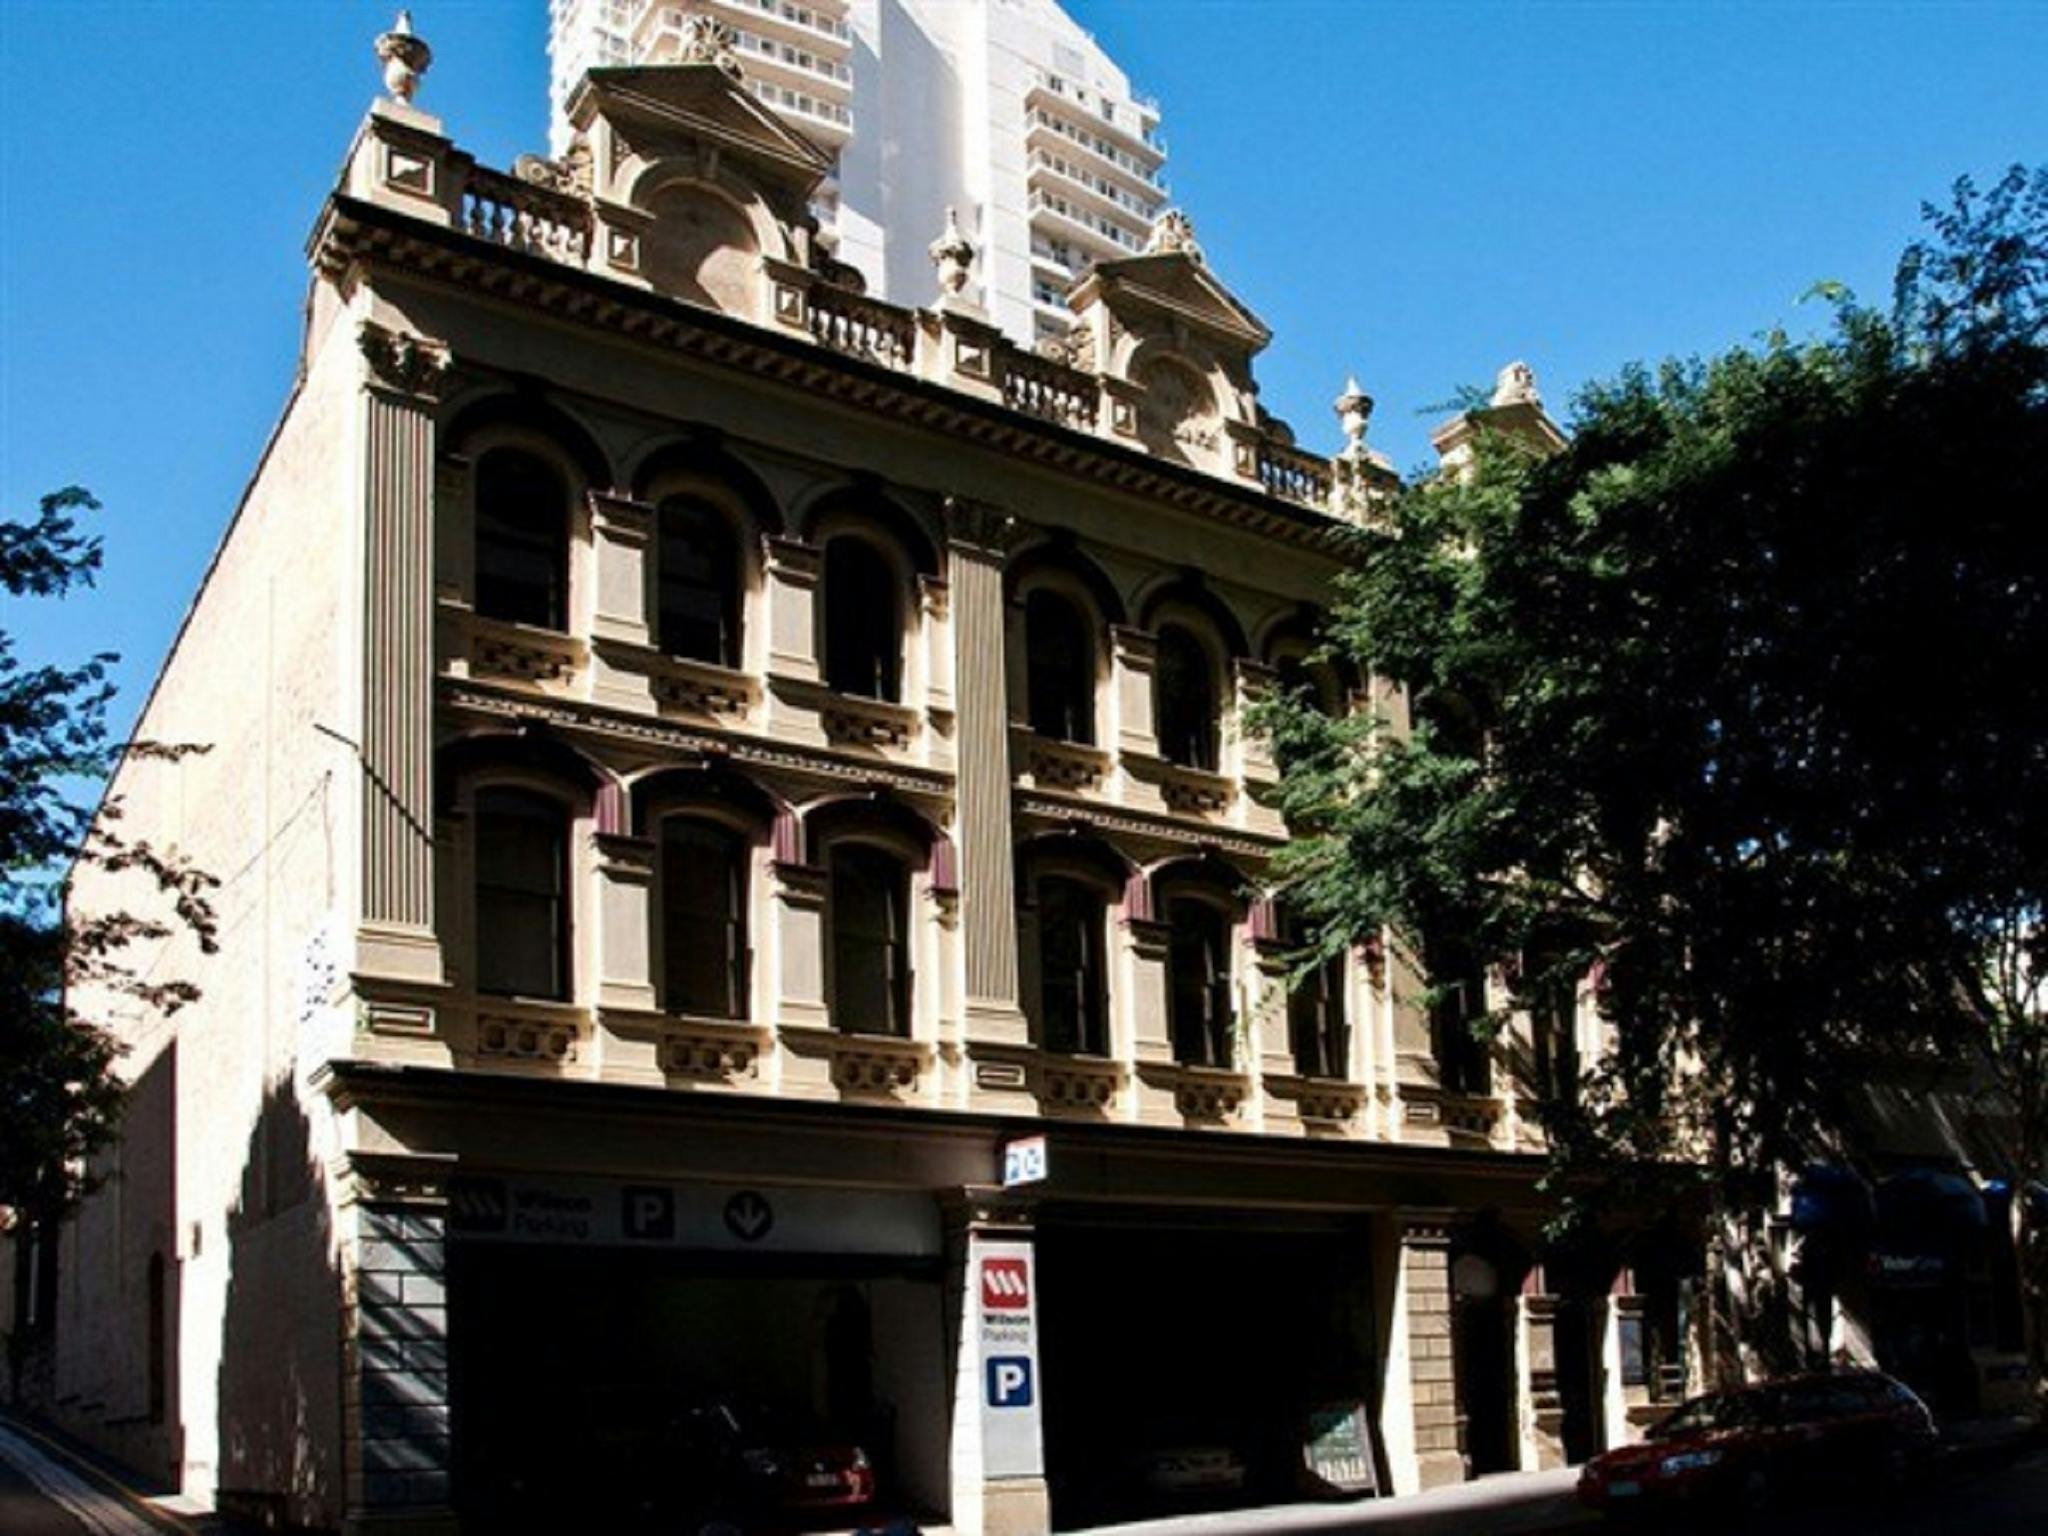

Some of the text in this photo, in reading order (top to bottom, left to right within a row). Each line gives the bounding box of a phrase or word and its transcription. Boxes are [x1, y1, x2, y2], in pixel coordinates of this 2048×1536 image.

[514, 1190, 591, 1211] Wilson
[633, 1194, 663, 1233] P
[514, 1214, 589, 1238] Parking
[983, 1314, 1031, 1325] Wilson
[982, 1328, 1029, 1344] Parking
[996, 1364, 1026, 1402] P
